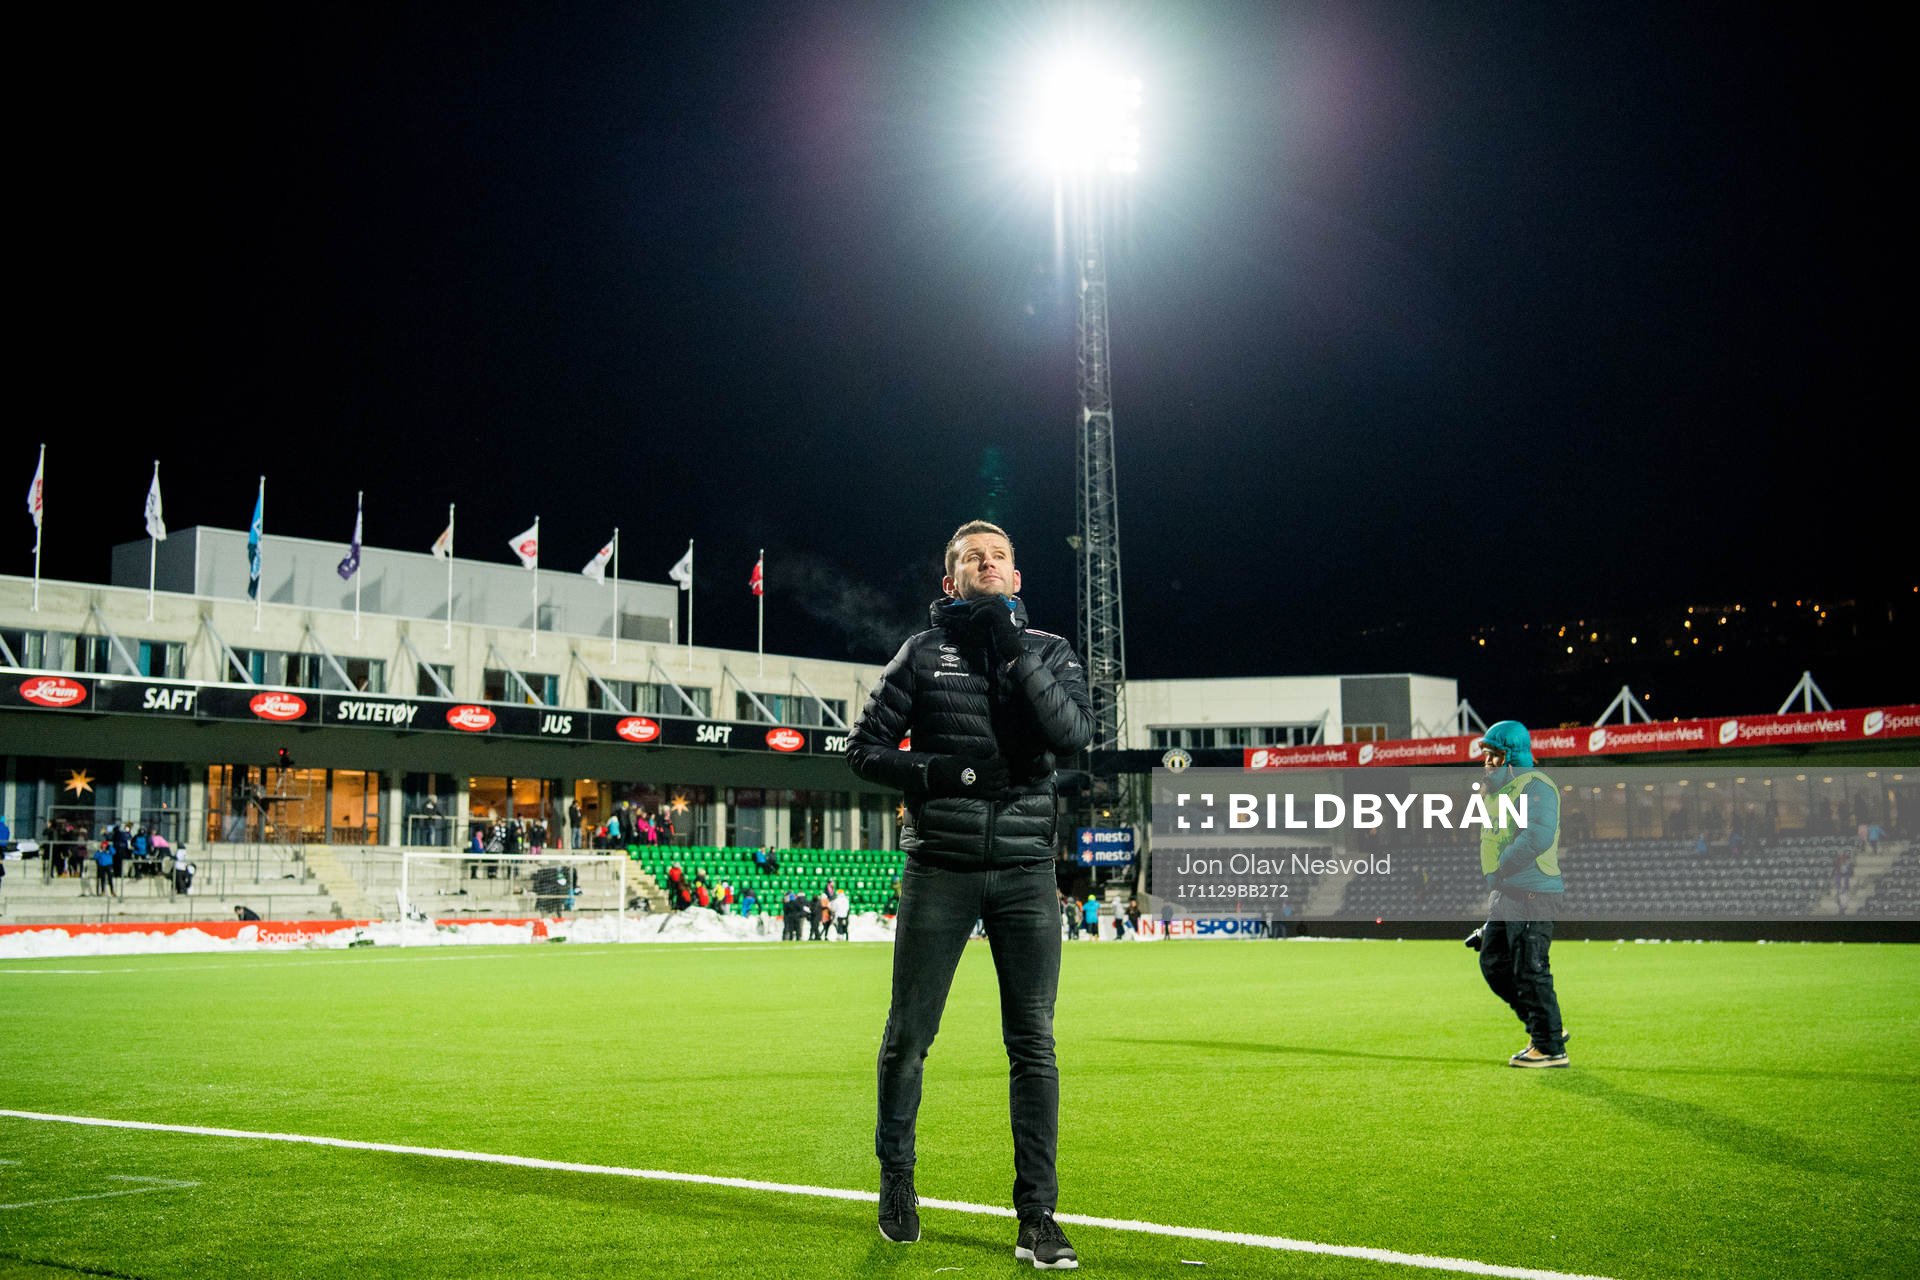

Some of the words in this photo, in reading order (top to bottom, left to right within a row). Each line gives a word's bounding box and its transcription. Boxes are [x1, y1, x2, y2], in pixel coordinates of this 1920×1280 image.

[143, 687, 197, 711] SAFT
[337, 700, 419, 725] SYLTETØY
[542, 714, 573, 734] JUS
[696, 725, 732, 744] SAFT
[825, 735, 849, 752] SYL
[1095, 831, 1131, 843] mesta
[1095, 850, 1131, 861] mesta
